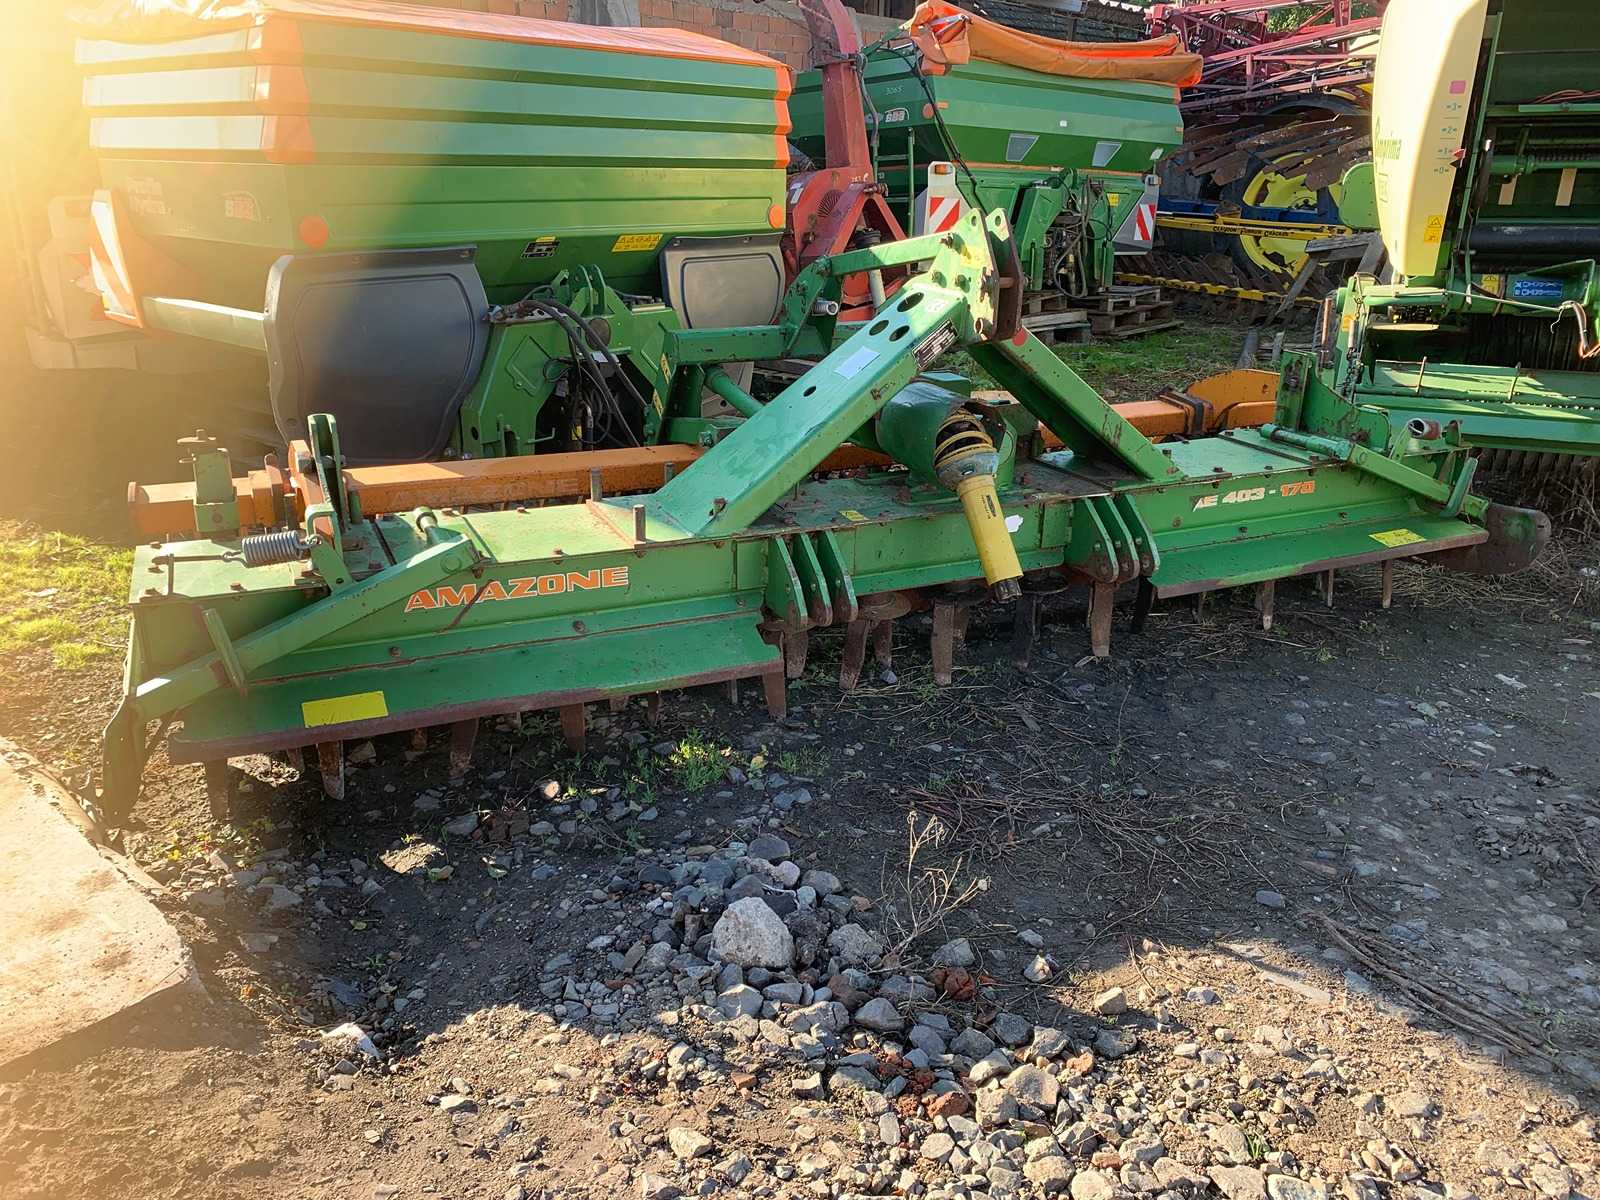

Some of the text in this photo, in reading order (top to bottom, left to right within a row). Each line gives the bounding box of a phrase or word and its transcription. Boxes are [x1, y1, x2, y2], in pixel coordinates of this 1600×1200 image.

[1222, 487, 1265, 504] 403
[1280, 480, 1316, 497] 170
[404, 566, 629, 613] AMAZONE
